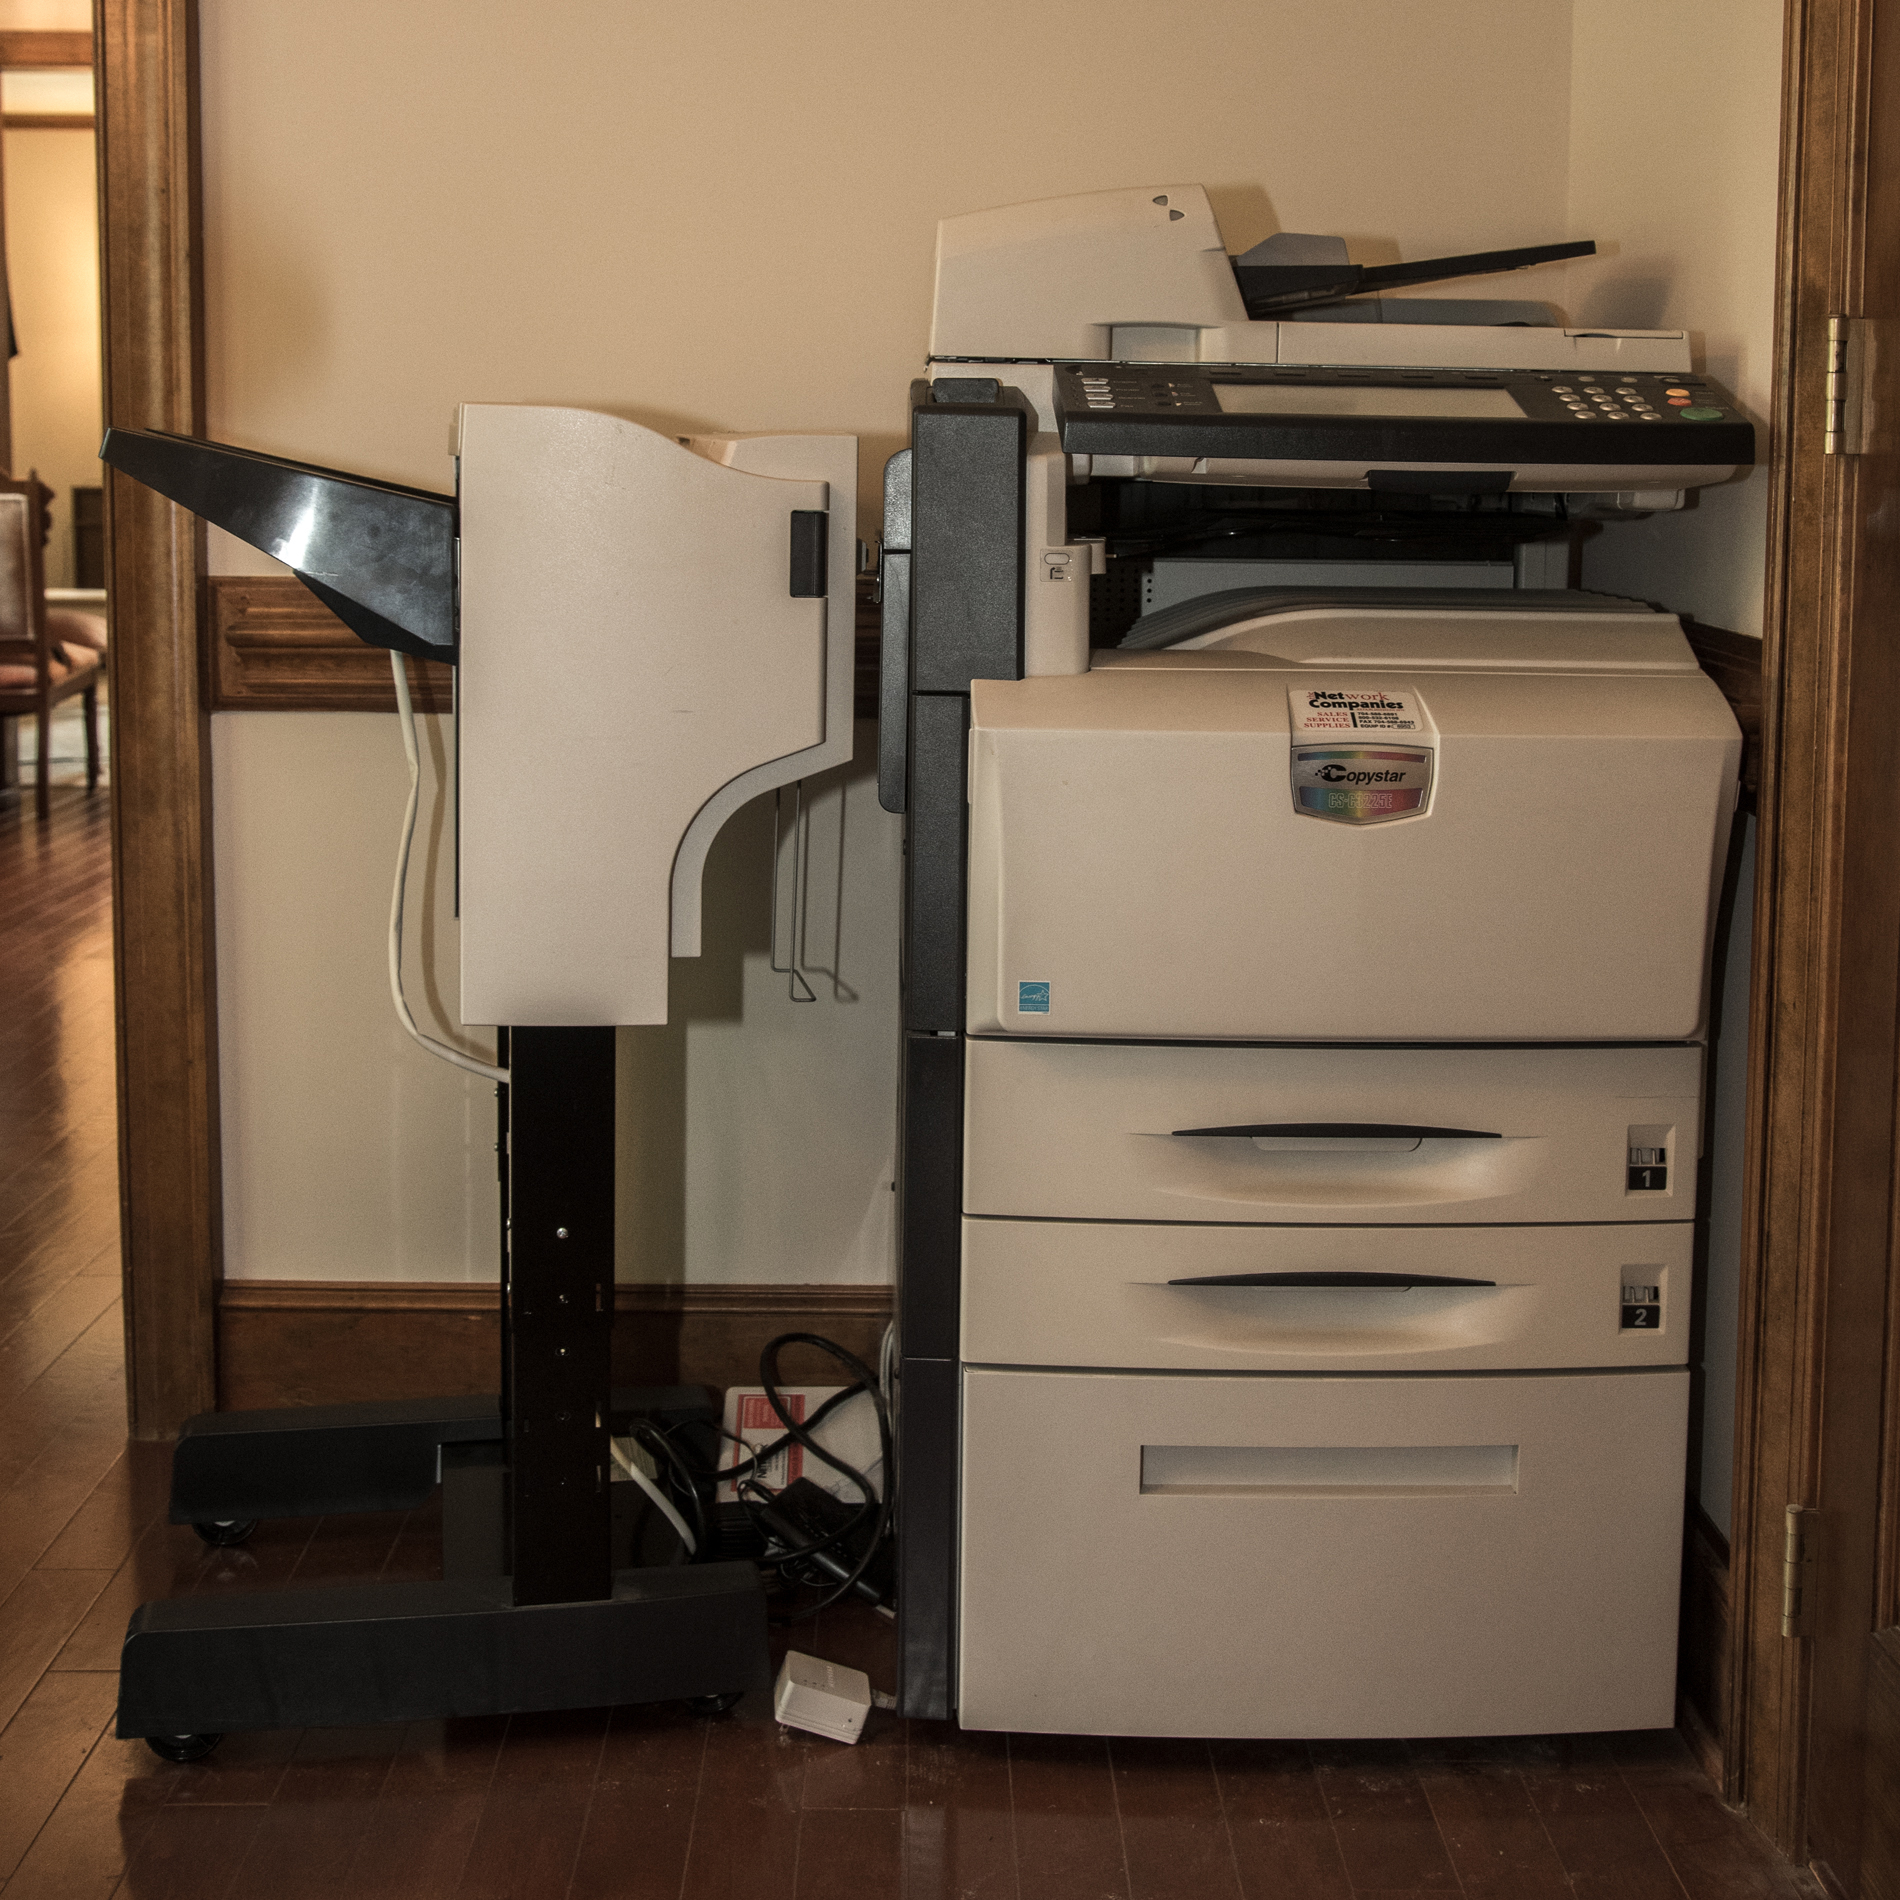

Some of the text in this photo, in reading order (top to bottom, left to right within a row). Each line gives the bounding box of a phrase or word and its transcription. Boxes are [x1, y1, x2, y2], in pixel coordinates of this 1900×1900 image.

[1314, 691, 1390, 700] Network
[1309, 700, 1404, 711] Companies
[1315, 764, 1406, 785] Copystar
[1328, 793, 1393, 809] CS-C3225E
[1642, 1170, 1651, 1188] 1
[1634, 1308, 1647, 1326] 2
